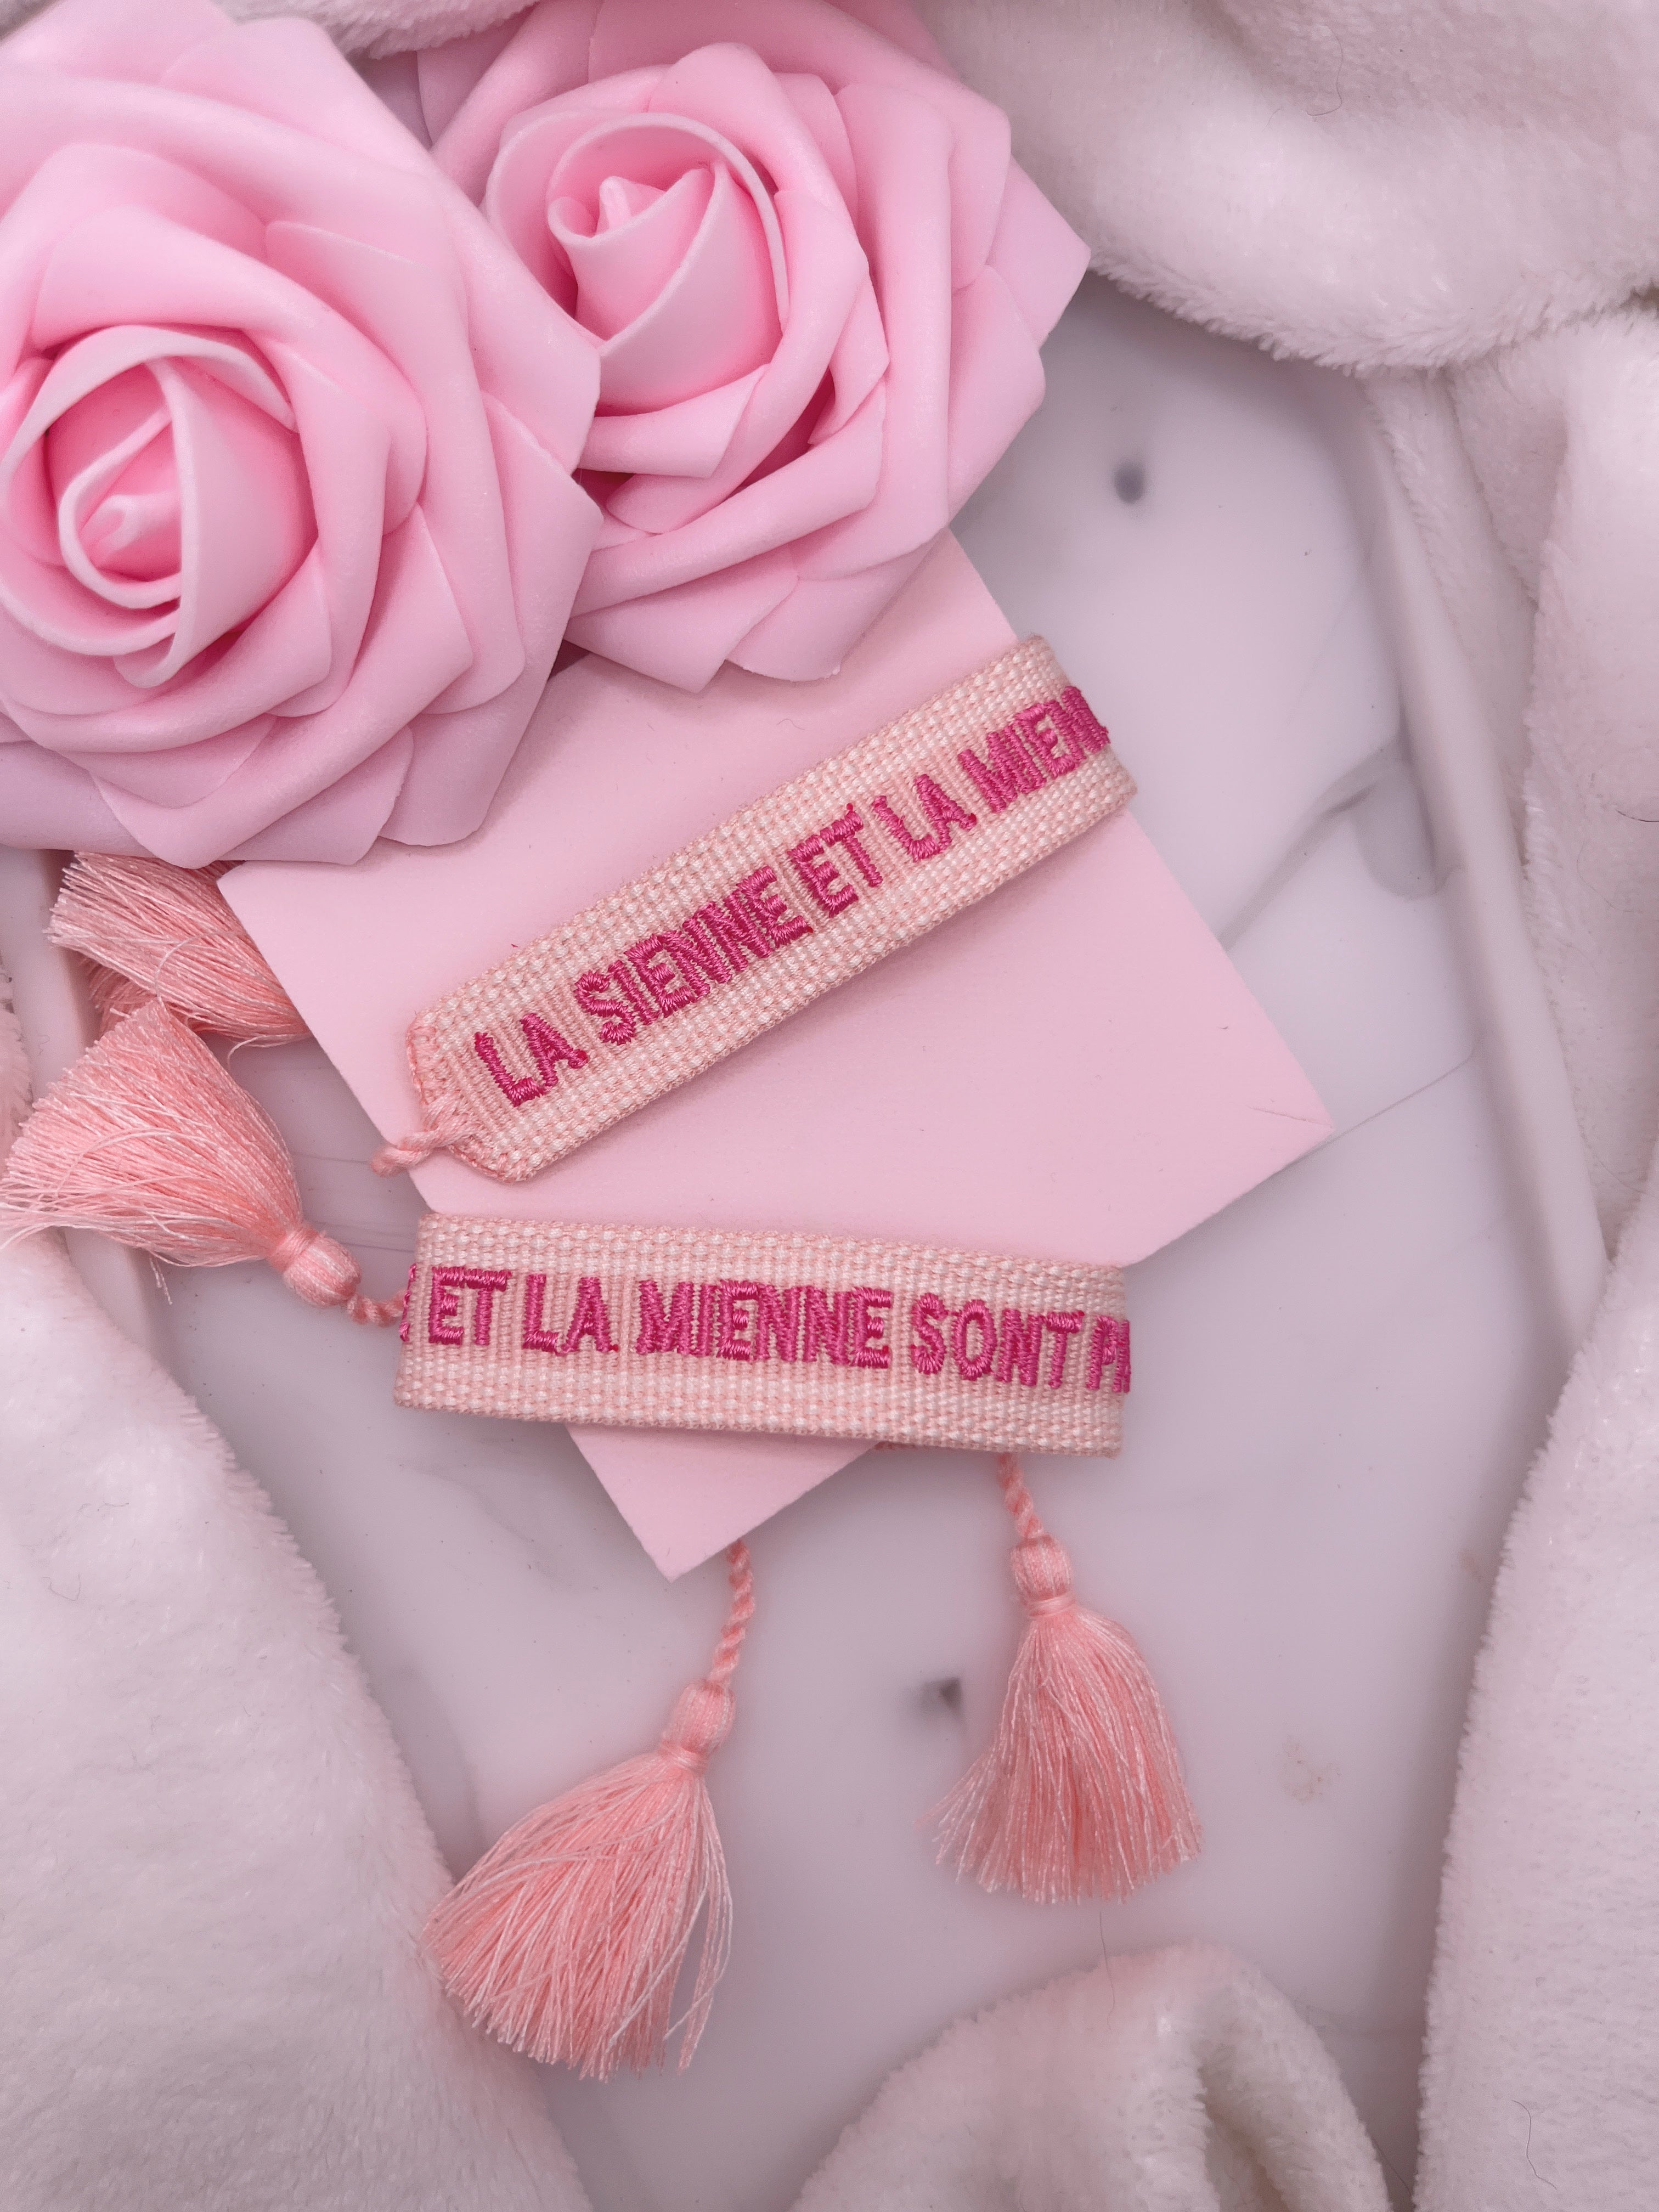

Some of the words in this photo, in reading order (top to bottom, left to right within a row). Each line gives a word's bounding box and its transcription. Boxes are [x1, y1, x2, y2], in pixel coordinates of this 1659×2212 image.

[474, 1013, 589, 1108] LA
[573, 865, 815, 1047] SIENNE
[786, 804, 884, 918] ET
[870, 774, 978, 864] LA
[427, 1266, 513, 1347] ET
[521, 1273, 619, 1356] LA
[635, 1279, 894, 1370] MIENNE
[909, 1293, 1085, 1390] SONT
